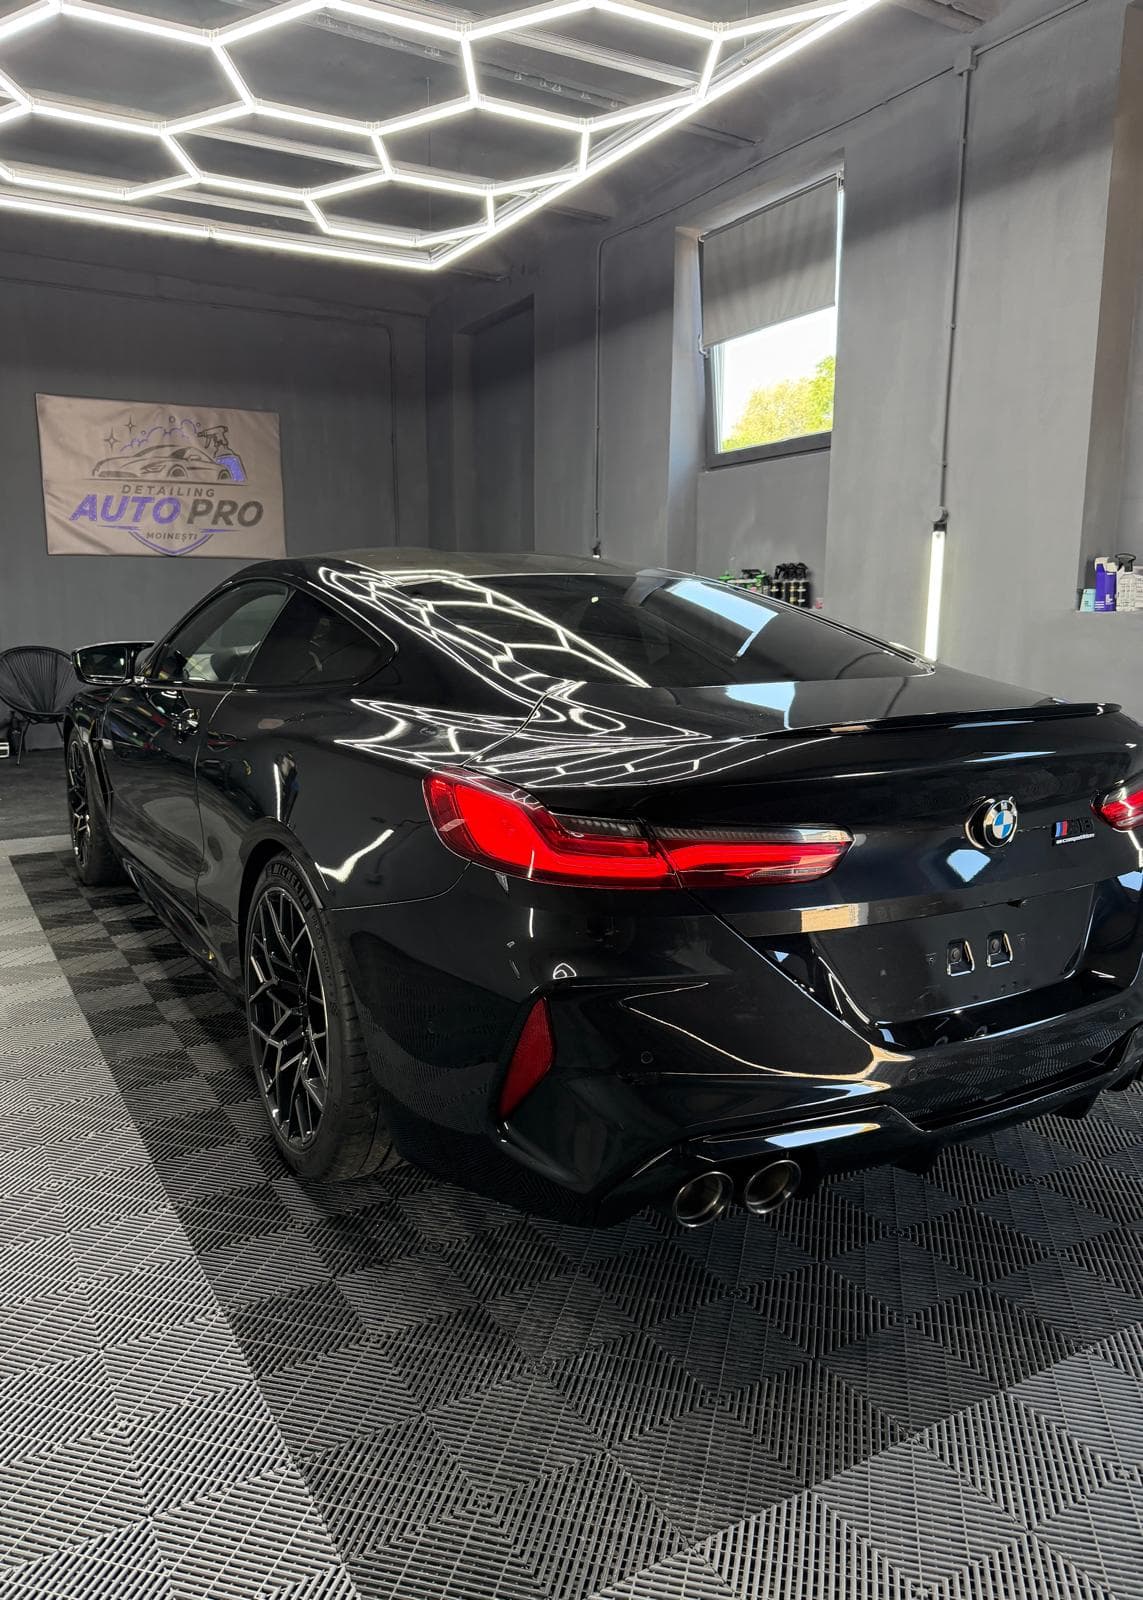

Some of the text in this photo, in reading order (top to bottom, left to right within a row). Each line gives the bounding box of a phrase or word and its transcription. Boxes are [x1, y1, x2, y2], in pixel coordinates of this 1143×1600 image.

[121, 484, 216, 498] DETAILING
[69, 494, 264, 527] AUTO PRO
[272, 863, 311, 910] MICHELIN
